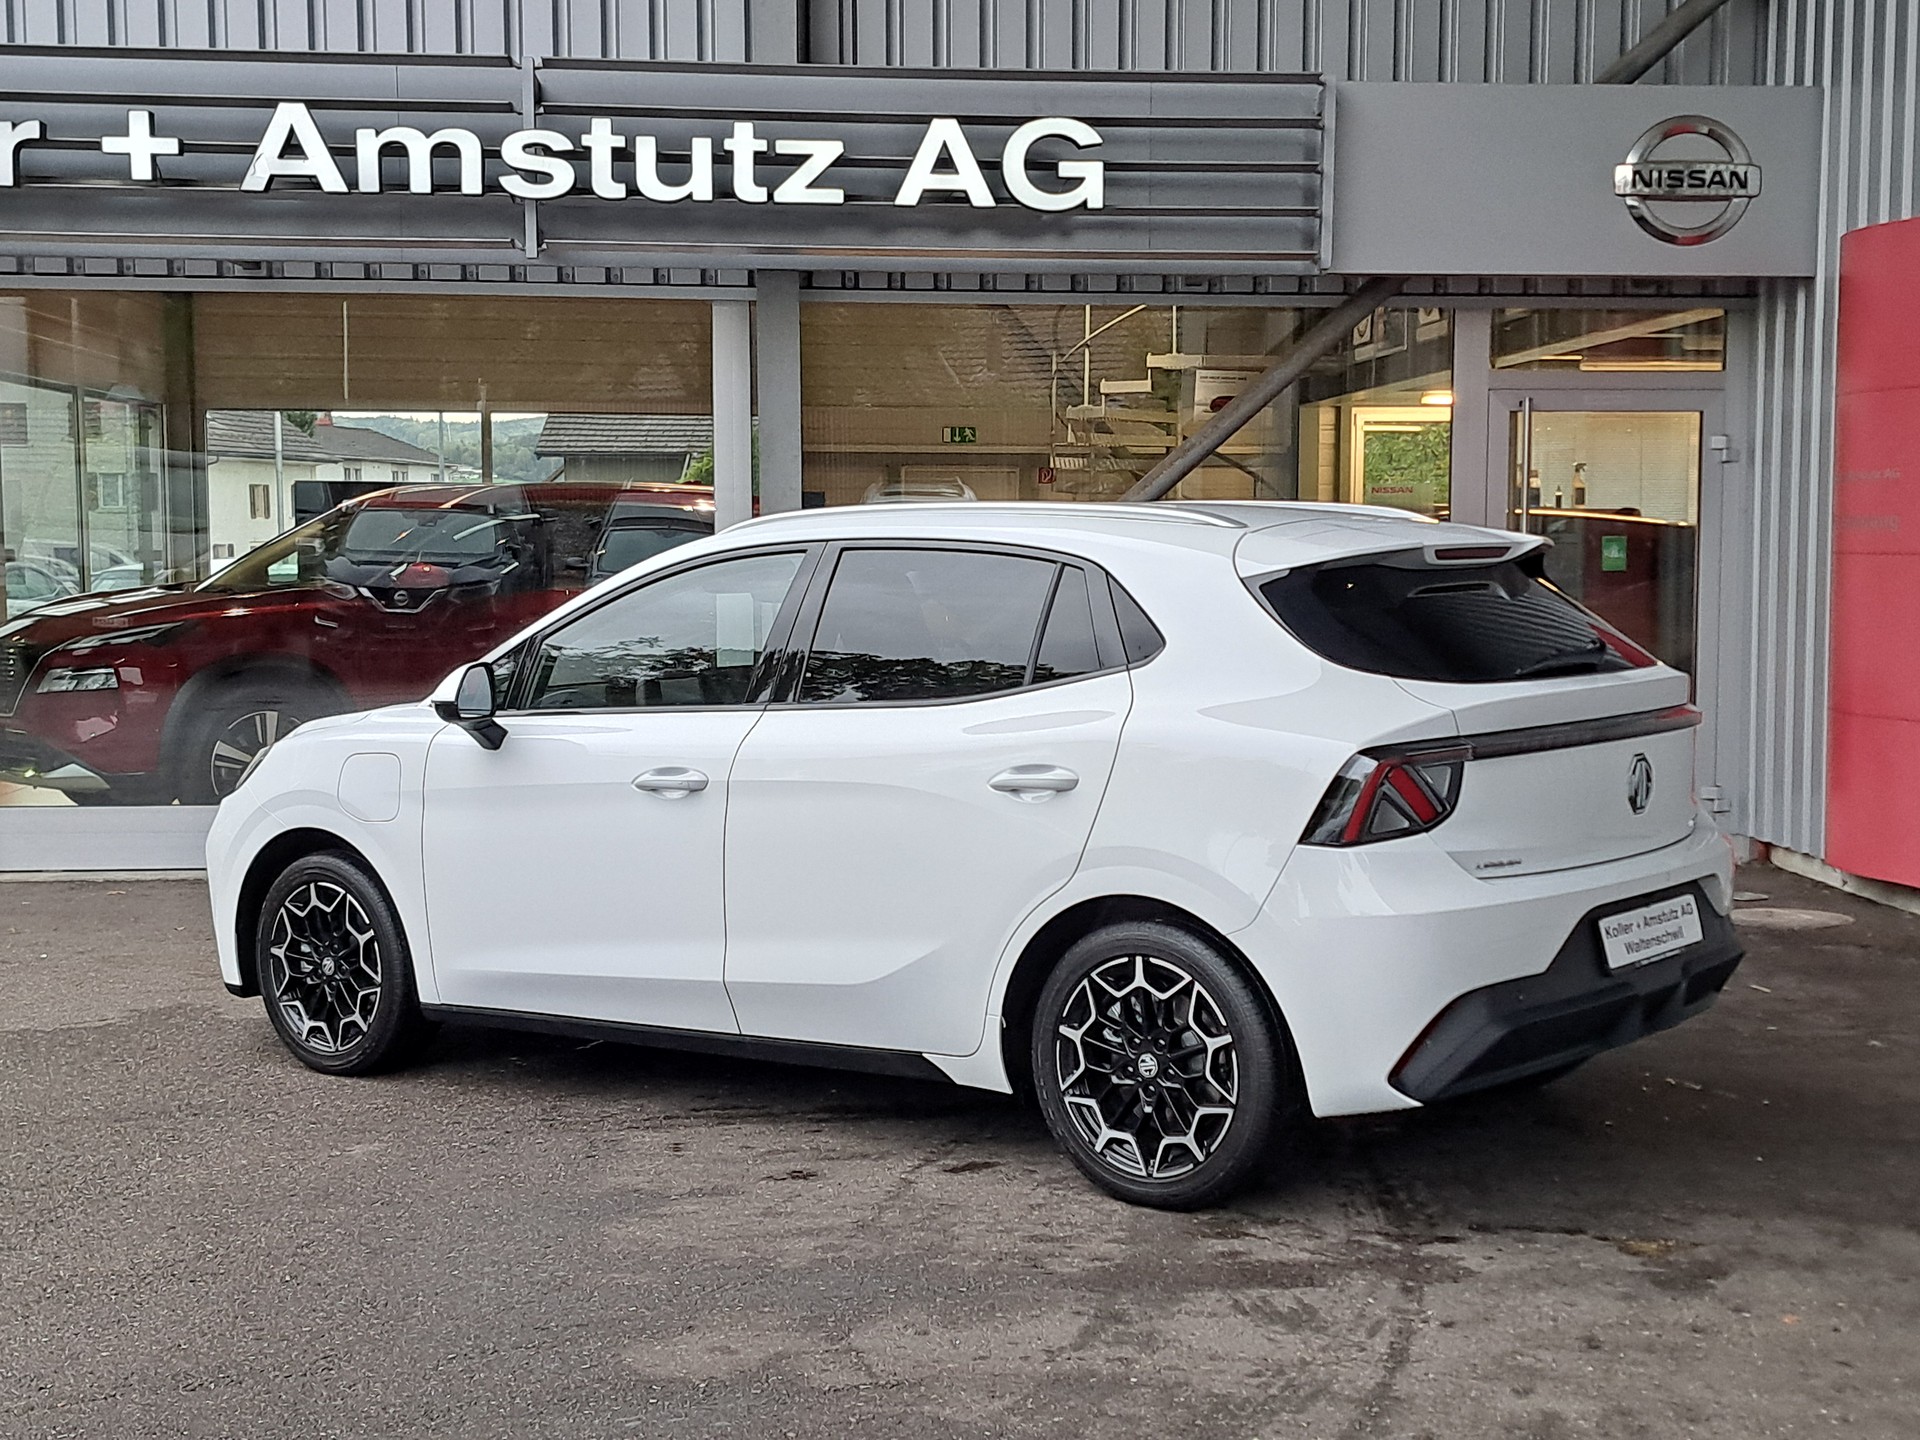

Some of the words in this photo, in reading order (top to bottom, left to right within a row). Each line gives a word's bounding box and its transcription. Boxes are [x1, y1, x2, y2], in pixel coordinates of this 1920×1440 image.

[102, 110, 180, 180] +
[240, 102, 845, 204] Amstutz
[894, 117, 1105, 211] AG
[1632, 169, 1748, 189] NISSAN
[1371, 486, 1414, 494] NISSAN
[1604, 921, 1634, 940] Koller
[1643, 908, 1679, 929] Amstutz
[1681, 902, 1694, 917] AG
[1623, 925, 1685, 955] Waltenschwil
